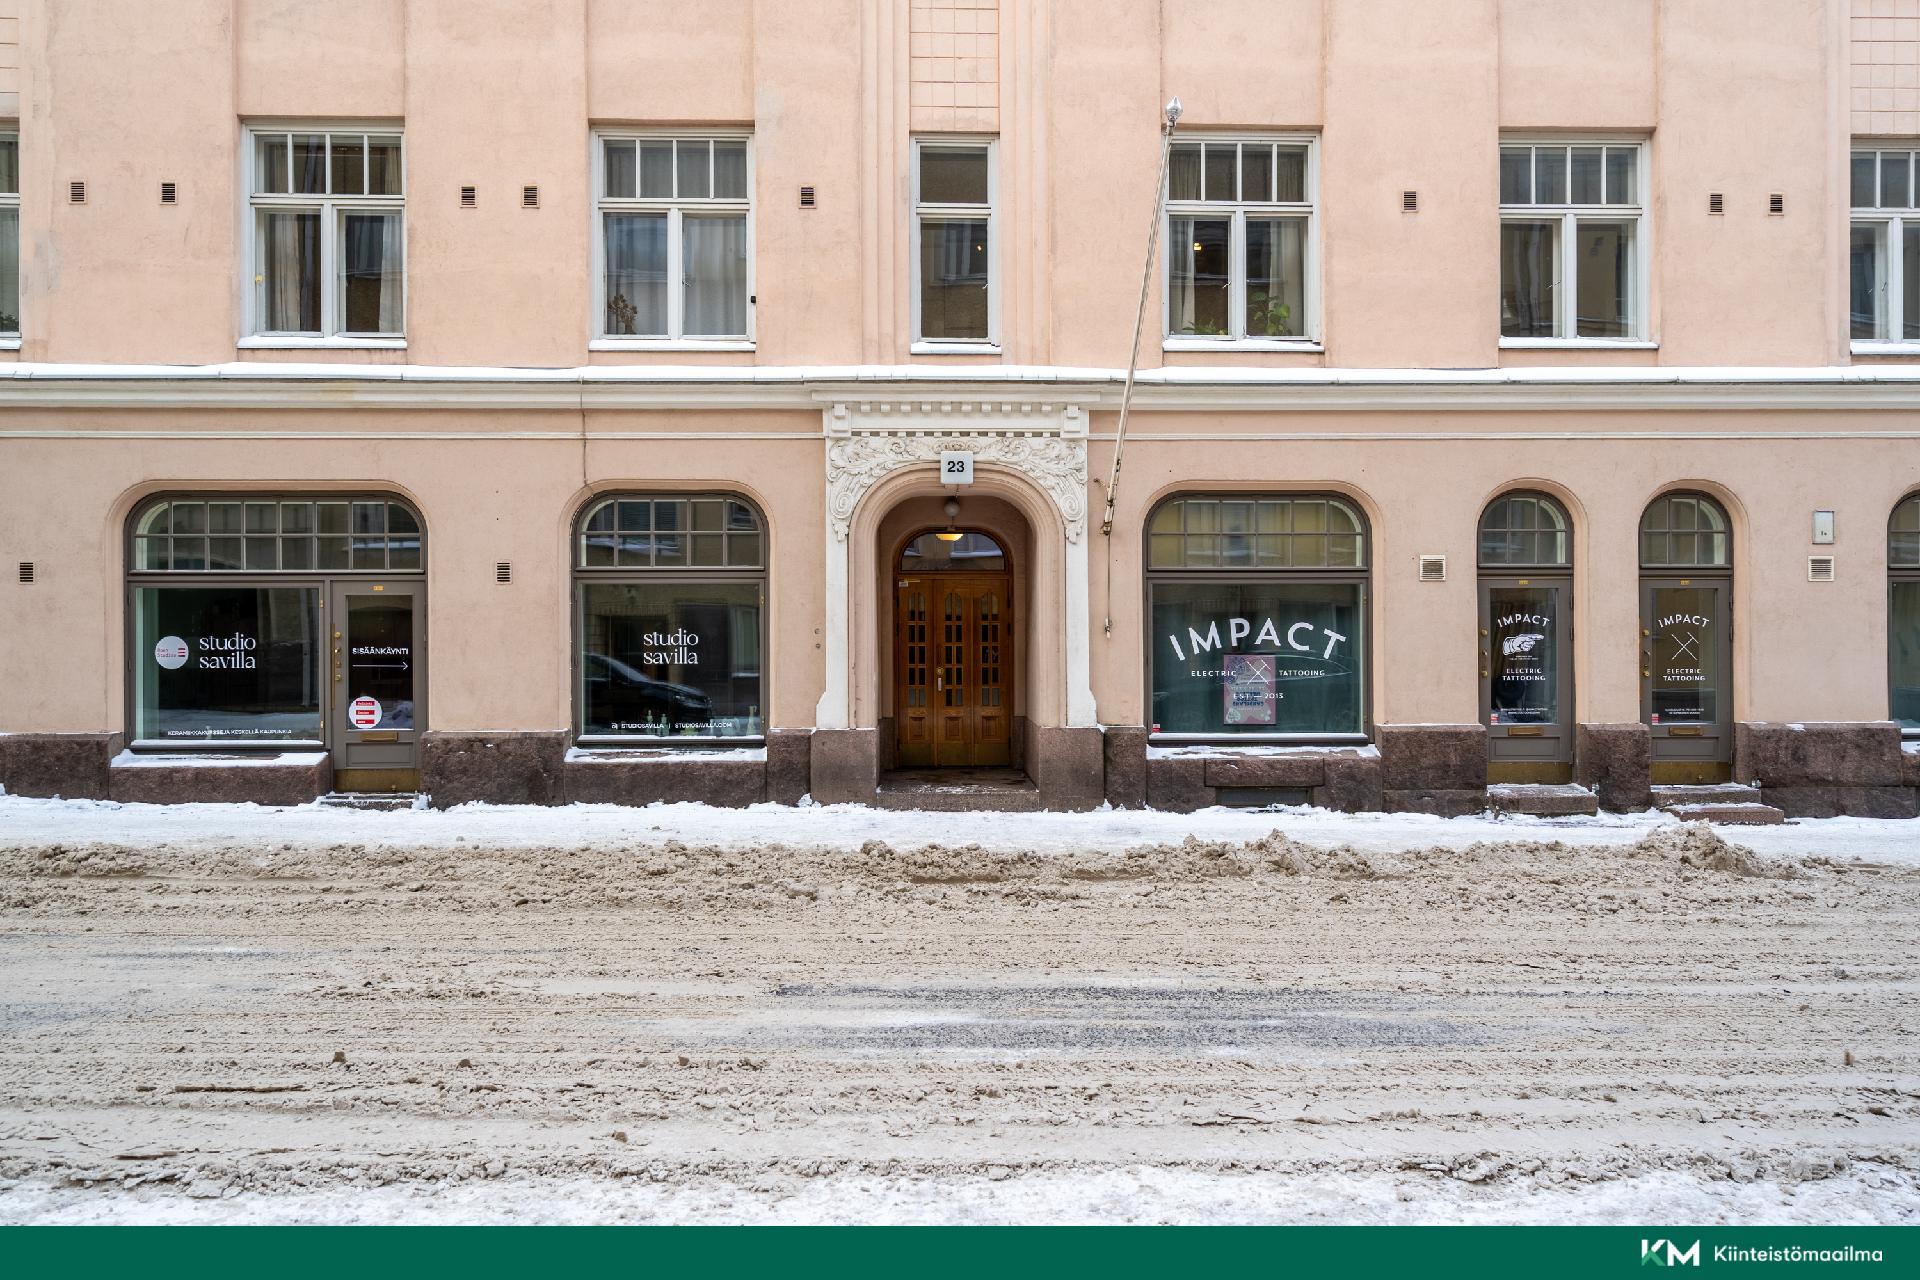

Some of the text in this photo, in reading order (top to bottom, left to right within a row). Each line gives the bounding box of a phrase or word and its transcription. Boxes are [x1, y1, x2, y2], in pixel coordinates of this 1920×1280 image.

[947, 460, 965, 473] 23
[1497, 613, 1550, 628] IMPACT
[1658, 613, 1710, 628] IMPACT
[199, 632, 257, 650] studio
[643, 628, 699, 646] studio
[1169, 617, 1347, 661] IMPACT
[352, 646, 409, 655] SISÄÄNKÄYNTI
[643, 646, 699, 665] savilla
[199, 651, 257, 669] savilla
